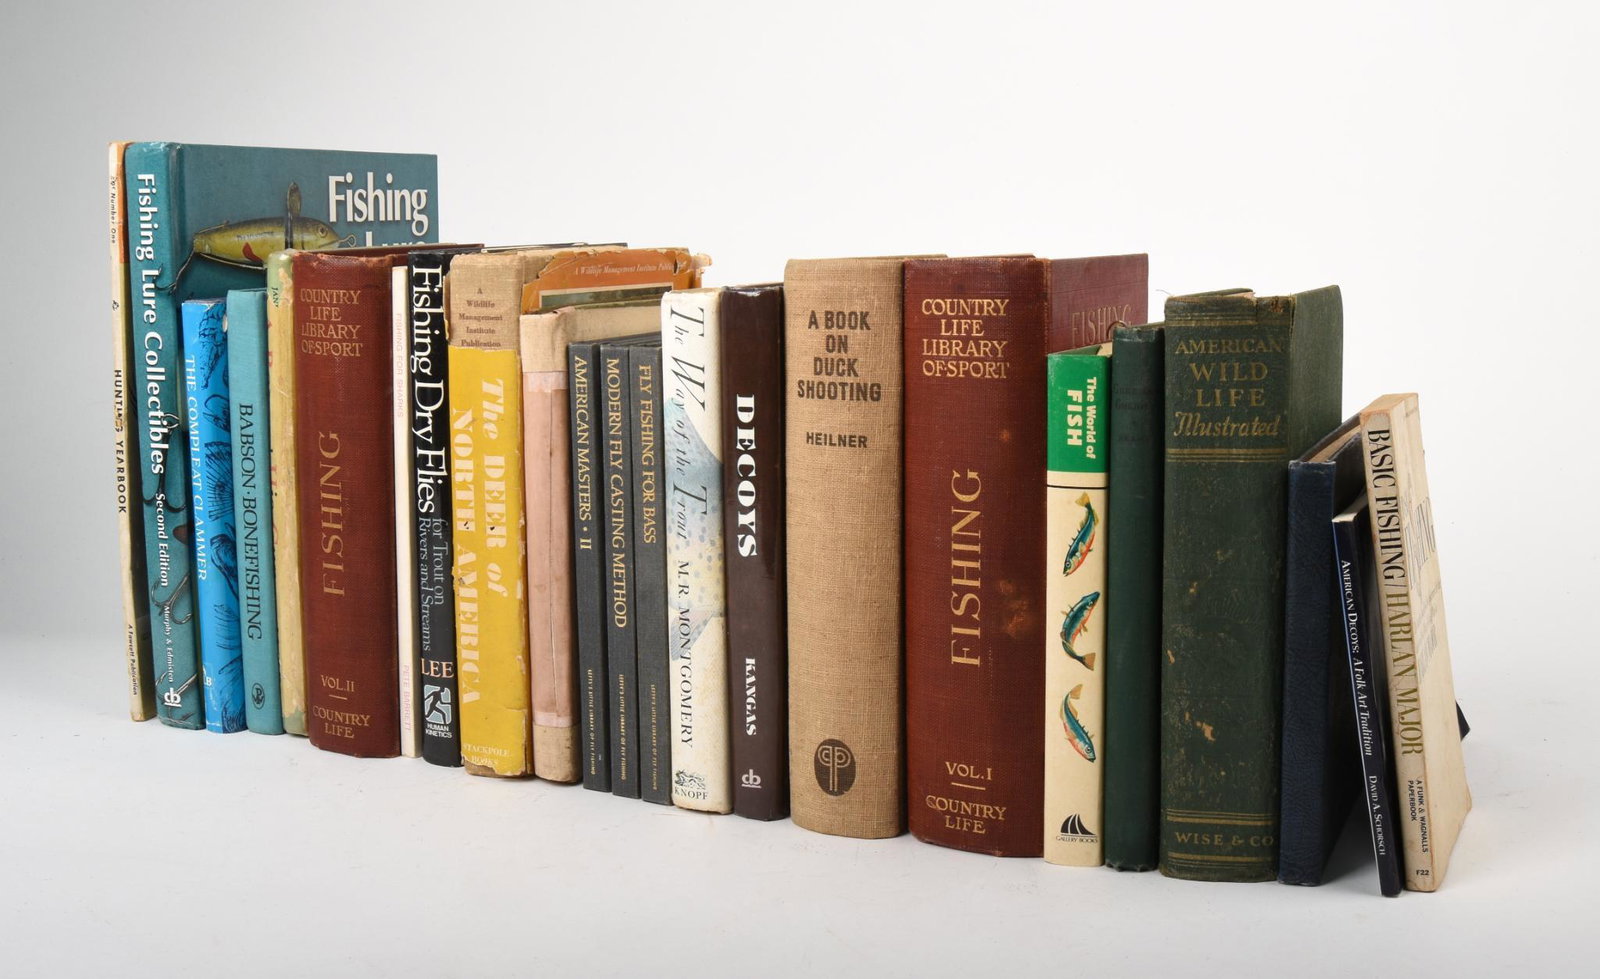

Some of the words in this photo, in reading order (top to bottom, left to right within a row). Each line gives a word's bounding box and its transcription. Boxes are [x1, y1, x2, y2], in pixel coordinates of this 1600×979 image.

[135, 173, 159, 261] Fishing
[328, 171, 429, 237] Fishing
[141, 270, 162, 324] Lure
[301, 288, 361, 305] COUNTRY
[466, 299, 496, 309] Wildlife
[921, 298, 1010, 316] COUNTRY
[309, 306, 342, 322] LIFE
[410, 264, 442, 376] Fishing
[458, 313, 503, 323] Management
[669, 305, 705, 346] The
[808, 311, 820, 330] A
[824, 310, 871, 331] BOOK
[940, 319, 985, 337] LIFE
[301, 324, 361, 340] LIBRARY
[460, 339, 502, 348] Publication
[465, 326, 496, 336] Institute
[825, 335, 848, 354] ON
[1174, 336, 1283, 355] AMERICAN
[922, 339, 1009, 358] LIBRARY
[184, 355, 197, 392] THE
[638, 364, 653, 397] FLY
[670, 356, 706, 411] Way
[813, 356, 859, 378] DUCK
[1189, 361, 1269, 383] WILD
[144, 331, 169, 474] Collectibles
[574, 355, 592, 445] AMERICAN
[606, 357, 622, 436] MODERN
[797, 379, 882, 402] SHOOTING
[1087, 376, 1097, 402] The
[1195, 388, 1266, 408] LIFE
[411, 381, 445, 444] Dry
[481, 378, 505, 440] The
[1066, 389, 1083, 446] FISH
[1086, 404, 1097, 446] World
[1173, 411, 1281, 437] Illustrated
[187, 396, 203, 488] COMPLEAT
[639, 399, 655, 466] FISHING
[675, 419, 691, 445] of
[806, 431, 868, 449] HEILNER
[452, 407, 476, 532] NORTH
[608, 439, 623, 470] FLY
[675, 448, 692, 476] the
[1085, 448, 1096, 459] of
[116, 440, 127, 514] YEARBOOK
[416, 446, 449, 513] Flies
[577, 447, 592, 521] MASTERS
[641, 469, 656, 503] FOR
[736, 393, 757, 558] DECOYS
[155, 493, 169, 539] Second
[318, 430, 345, 597] FISHING
[483, 455, 507, 549] DEER
[610, 473, 626, 549] CASTING
[673, 484, 708, 540] Trout
[193, 495, 207, 581] CLAMMER
[418, 517, 432, 559] Rivers
[432, 517, 449, 539] for
[643, 506, 657, 544] BASS
[579, 537, 592, 551] II
[158, 541, 171, 587] Edition
[420, 562, 434, 593] and
[432, 541, 449, 582] Trout
[677, 560, 690, 579] M.
[950, 468, 982, 668] FISHING
[433, 585, 446, 605] on
[486, 562, 508, 597] of
[612, 553, 628, 629] METHOD
[678, 583, 690, 599] R.
[1341, 559, 1357, 612] AMERICAN
[1368, 428, 1397, 489] BASIC
[1395, 689, 1425, 755] MAJOR
[163, 604, 171, 637] Murphy
[420, 594, 434, 652] Streams
[457, 545, 481, 704] AMERICA
[421, 657, 454, 679] LEE
[678, 606, 693, 748] MONTGOMERY
[1353, 656, 1362, 667] A
[1354, 668, 1365, 689] Folk
[745, 657, 757, 736] KANGAS
[1357, 690, 1368, 709] Art
[312, 705, 371, 727] COUNTRY
[325, 723, 355, 739] LIFE
[426, 723, 450, 732] HUMAN
[425, 729, 453, 739] KINETICS
[1359, 710, 1373, 757] Tradition
[674, 788, 709, 800] KNOPF
[1368, 775, 1379, 804] DAVID
[1407, 780, 1417, 822] PAPERBOOK
[1417, 786, 1425, 806] FUNK
[925, 794, 1006, 821] COUNTRY
[1371, 805, 1380, 814] A.
[944, 814, 987, 835] LIFE
[1175, 831, 1225, 846] WISE
[1231, 833, 1246, 846] &
[1374, 814, 1386, 856] SCHORSCH
[1419, 815, 1429, 853] WAGNALLS
